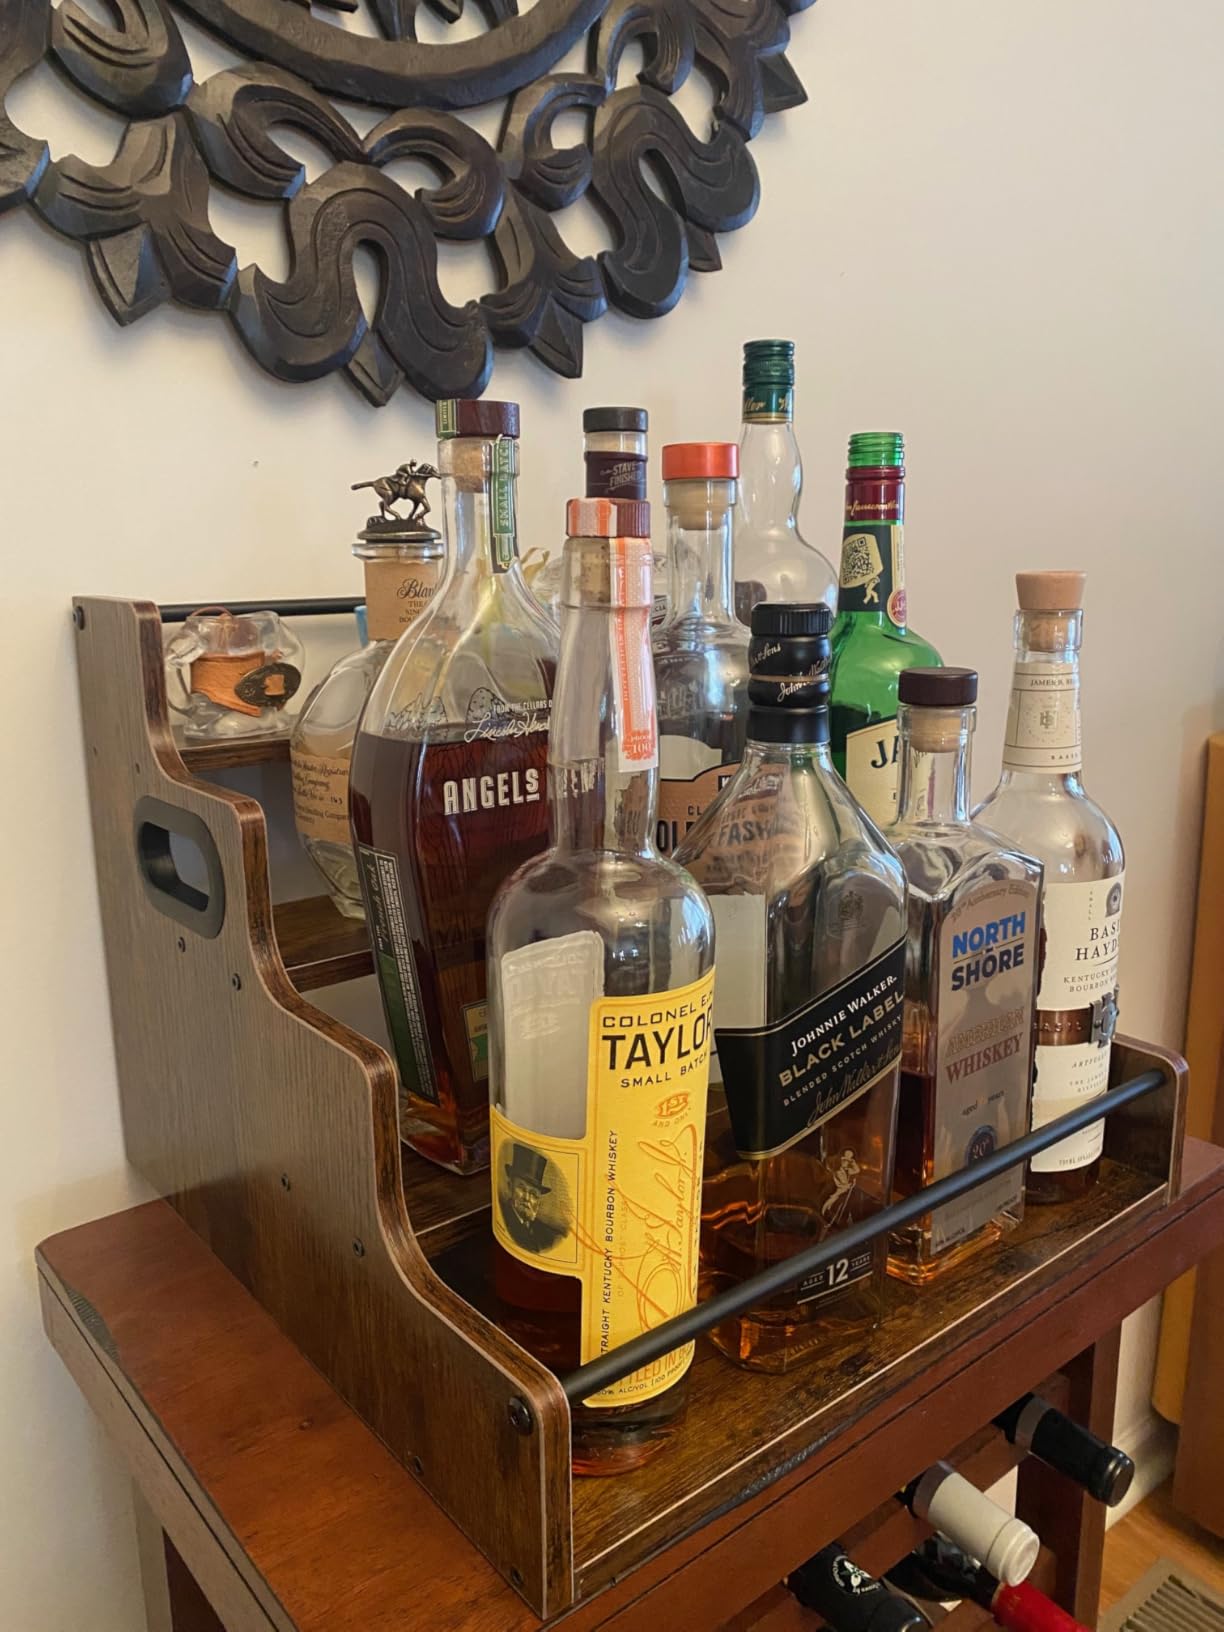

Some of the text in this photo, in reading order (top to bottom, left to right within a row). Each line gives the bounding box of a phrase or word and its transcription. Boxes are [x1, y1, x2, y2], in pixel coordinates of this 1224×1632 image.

[498, 485, 509, 527] SMALL
[632, 742, 652, 753] 100
[443, 768, 540, 816] ANGELS
[952, 911, 1026, 959] NORTH
[1063, 969, 1109, 984] KENTUCKY
[1069, 980, 1109, 993] BOURBON
[603, 1003, 697, 1028] COLONEL
[791, 1009, 848, 1057] JOHNNIE
[778, 1032, 846, 1087] BLACK
[849, 991, 905, 1040] LABEL
[783, 1015, 903, 1107] BLENDED SCOTCH WHISKY
[946, 1032, 1024, 1084] WHISKEY
[621, 1072, 672, 1088] SMALL
[600, 1130, 618, 1354] TRAIGHT KENTUCKY BOURBON WHISKEY
[803, 1274, 824, 1287] AGED
[826, 1258, 849, 1286] 12
